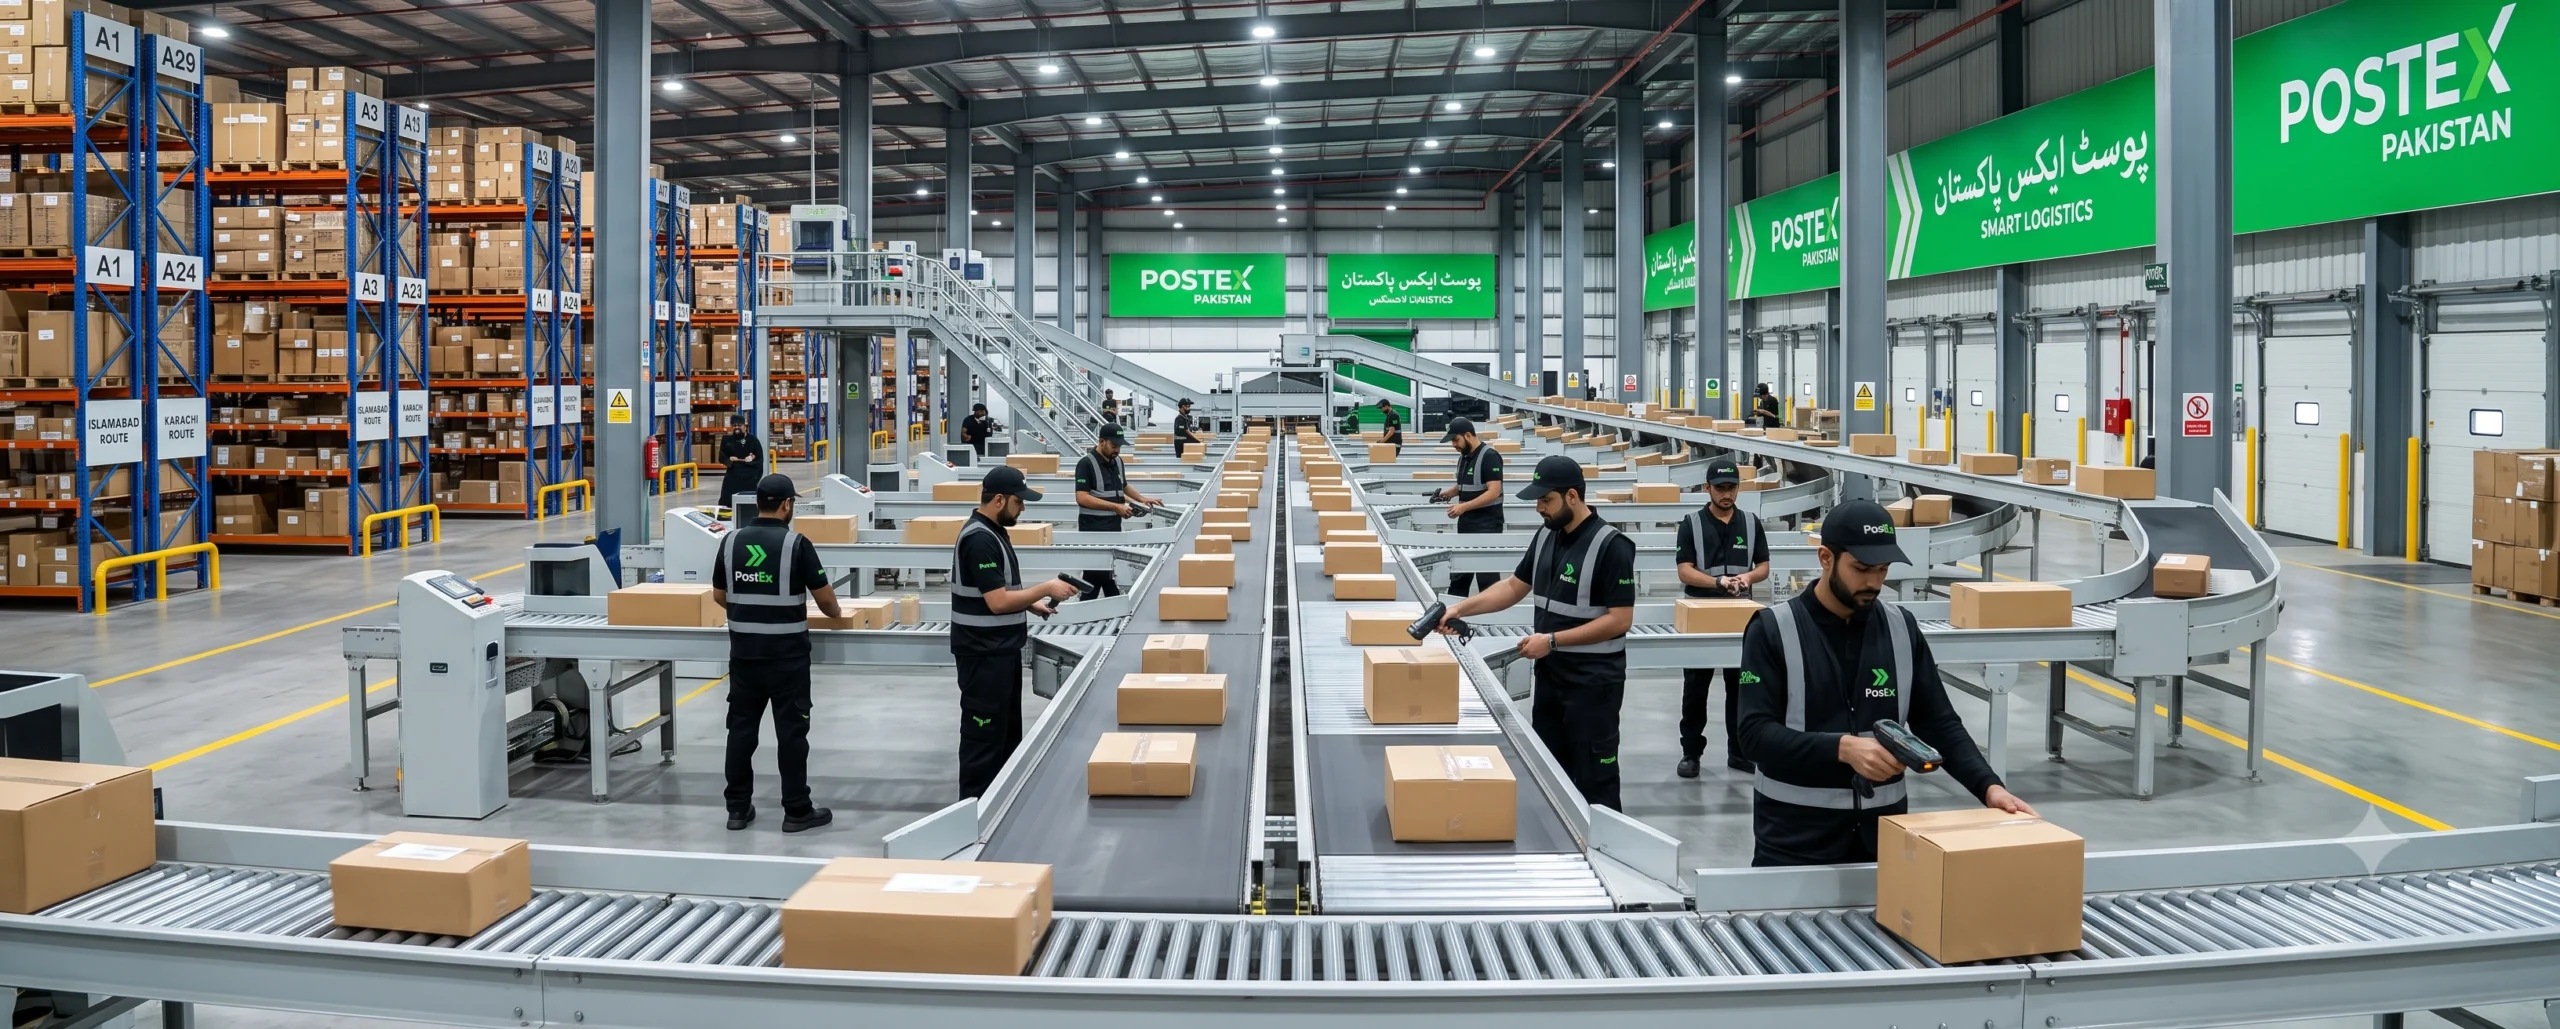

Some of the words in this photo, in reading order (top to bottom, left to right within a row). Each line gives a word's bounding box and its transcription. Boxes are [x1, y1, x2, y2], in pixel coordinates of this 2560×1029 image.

[95, 26, 119, 53] A1
[162, 45, 196, 73] A29
[2280, 2, 2517, 144] POSTEX
[361, 101, 378, 122] A3
[2382, 107, 2511, 162] PAKISTAN
[536, 149, 548, 166] A3
[2071, 128, 2149, 184] پوسٹ
[2008, 135, 2065, 202] ایکس
[1934, 154, 2002, 216] پاکستان
[1771, 196, 1840, 252] POSTEX
[1980, 212, 2022, 239] SMART
[2024, 198, 2094, 231] LOGISTICS
[96, 255, 120, 278] A1
[1802, 247, 1839, 267] PAKISTAN
[162, 260, 196, 282] A24
[1141, 265, 1254, 291] POSTEX
[1399, 271, 1437, 291] ایکس
[1440, 271, 1482, 292] پوسٹ
[362, 278, 378, 296] A3
[401, 282, 422, 299] A23
[1341, 271, 1395, 293] پاکستان
[1194, 294, 1252, 304] PAKISTAN
[88, 417, 140, 430] ISLAMABAD
[164, 414, 199, 426] KARACHI
[364, 416, 382, 425] ROUTE
[100, 432, 129, 445] ROUTE
[168, 428, 195, 440] ROUTE
[734, 570, 773, 583] PostEx
[1865, 687, 1896, 698] PosEx
